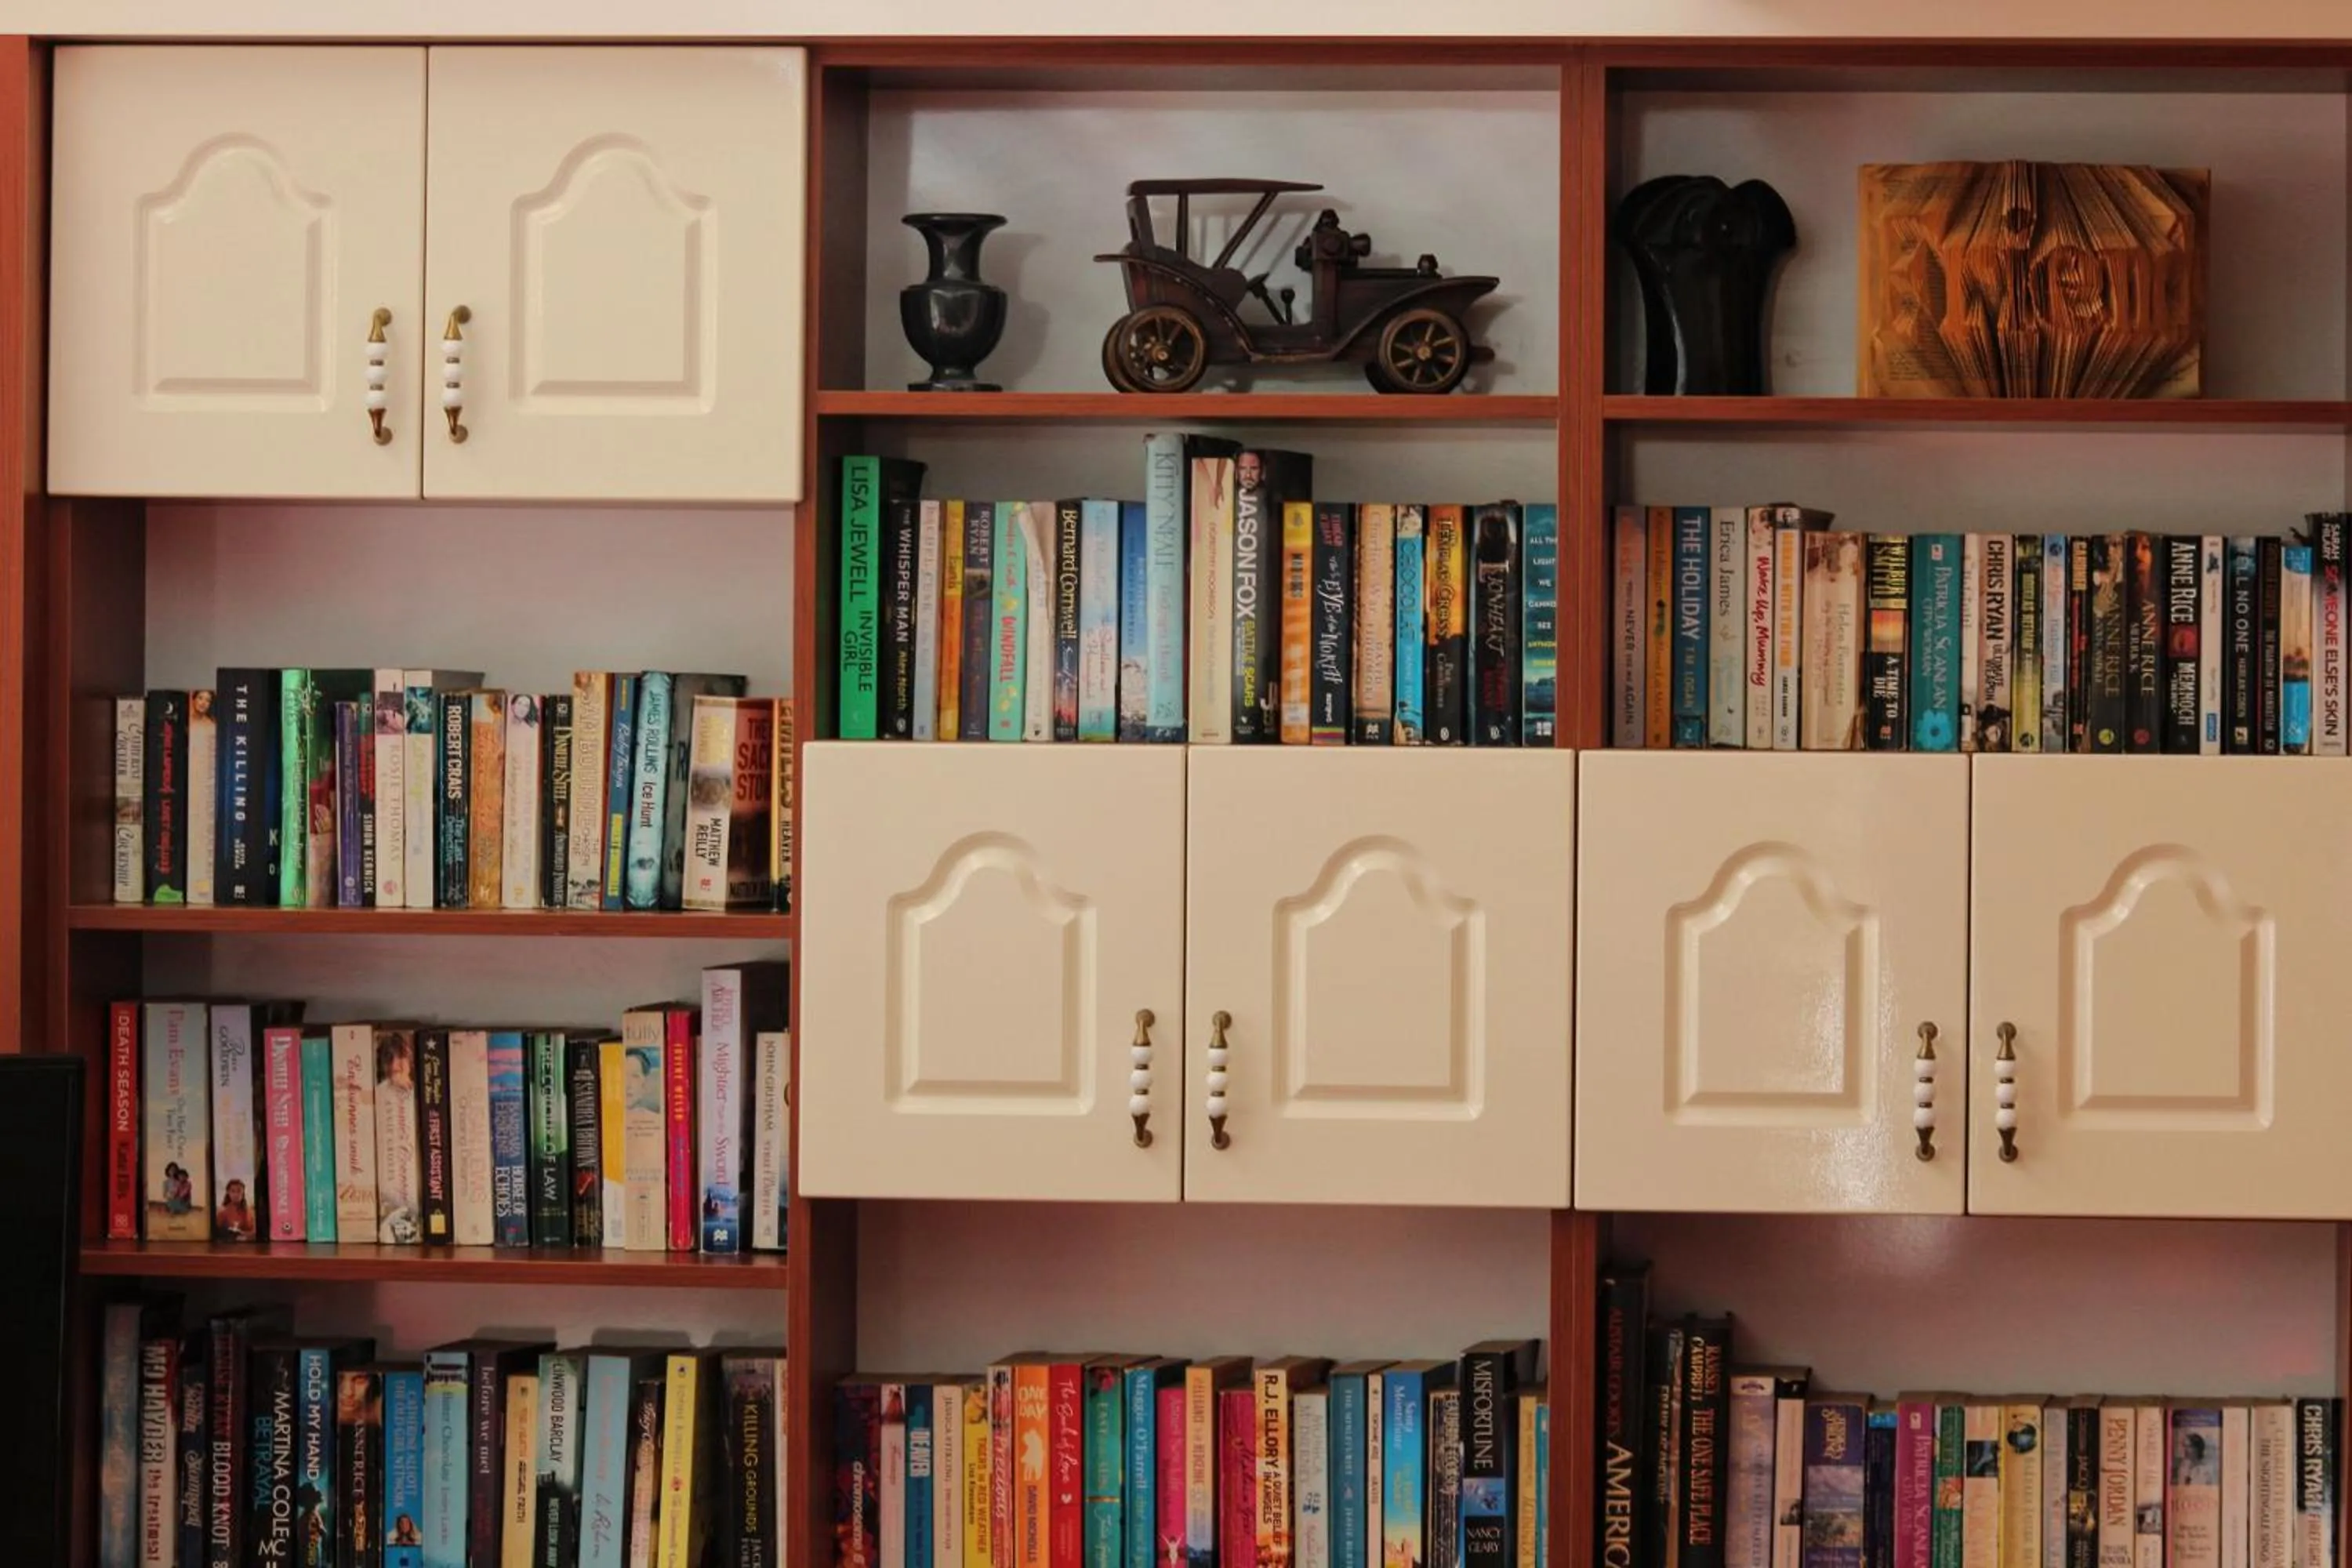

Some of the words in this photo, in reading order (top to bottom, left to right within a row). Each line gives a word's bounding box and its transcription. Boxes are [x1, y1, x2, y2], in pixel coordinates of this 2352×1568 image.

[850, 466, 869, 511] LISA
[978, 510, 990, 564] ROBERT
[1062, 509, 1079, 572] Bernard
[1237, 488, 1258, 570] JASON
[1682, 516, 1700, 554] THE
[1719, 521, 1735, 563] Erica
[2331, 523, 2339, 559] SARAH
[849, 518, 869, 603] JEWELL
[896, 528, 912, 601] WHISPER
[1756, 556, 1769, 597] Wake
[1889, 543, 1907, 593] WILBUR
[1987, 540, 2005, 589] CHRIS
[2171, 542, 2195, 585] ANNE
[1059, 572, 1077, 639] Cornwell
[1236, 572, 1256, 619] FOX
[1478, 559, 1509, 657] LIONHEART
[1681, 557, 1701, 640] HOLIDAY
[1719, 567, 1735, 617] James
[1934, 566, 1951, 630] PATRICIA
[1987, 591, 2005, 641] RYAN
[2171, 587, 2195, 623] RICE
[2236, 590, 2250, 614] NO
[2325, 565, 2339, 646] SOMEONE
[896, 606, 911, 643] MAN
[1624, 609, 1635, 651] NEVER
[2106, 600, 2121, 652] ANNE
[2141, 600, 2155, 652] ANNE
[2236, 619, 2249, 653] ONE
[843, 630, 858, 673] GIRL
[858, 610, 873, 692] INVISIBLE
[999, 615, 1017, 683] WINDFALL
[1749, 626, 1769, 687] Mummy
[1887, 656, 1896, 666] A
[1933, 636, 1951, 708] SCANLAN
[2325, 649, 2339, 697] ELSE'S
[1243, 666, 1254, 707] SCARS
[1873, 677, 1886, 698] DIE
[1886, 667, 1898, 698] TIME
[2105, 655, 2120, 698] RICE
[2141, 655, 2154, 697] RICE
[2178, 662, 2195, 725] MEMNOCH
[236, 684, 247, 722] THE
[648, 691, 662, 725] JAMES
[1624, 684, 1635, 724] AGAIN
[1886, 702, 1897, 718] TO
[2325, 699, 2338, 735] SKIN
[448, 705, 462, 757] ROBERT
[644, 728, 661, 774] ROLLINS
[236, 736, 246, 822] KILLING
[448, 759, 461, 799] CRAIS
[642, 782, 655, 797] Ice
[641, 800, 654, 829] Hunt
[696, 824, 709, 859] REILLY
[708, 818, 721, 867] MATTHEW
[118, 1016, 129, 1065] DEATH
[764, 1040, 775, 1074] JOHN
[167, 1048, 184, 1095] Evans
[711, 1041, 731, 1102] Mightier
[118, 1069, 129, 1131] SEASON
[764, 1076, 775, 1131] GRISHAM
[429, 1118, 441, 1147] FIRST
[544, 1142, 555, 1163] OF
[544, 1167, 557, 1200] LAW
[715, 1137, 731, 1185] Sword
[495, 1166, 511, 1218] ECHOES
[144, 1345, 166, 1379] MO
[308, 1355, 321, 1400] HOLD
[1705, 1345, 1720, 1395] RAMSEY
[480, 1366, 494, 1414] before
[551, 1363, 564, 1412] LINWOOD
[1134, 1374, 1147, 1423] Maggie
[1265, 1374, 1278, 1404] R.J.
[143, 1384, 166, 1463] HAYDER
[274, 1390, 290, 1477] MARTINA
[308, 1404, 321, 1432] MY
[354, 1418, 364, 1457] ANNE
[480, 1419, 491, 1441] we
[743, 1404, 758, 1467] KILLING
[1265, 1408, 1278, 1468] ELLORY
[1473, 1359, 1494, 1469] MISFORTUNE
[1692, 1409, 1715, 1435] THE
[2304, 1405, 2323, 1456] CHRIS
[307, 1432, 321, 1480] HAND
[478, 1446, 492, 1474] met
[550, 1415, 564, 1463] BARCLAY
[910, 1431, 929, 1477] DEAVER
[1135, 1428, 1148, 1489] O'Farrell
[1691, 1439, 1713, 1465] ONE
[2106, 1417, 2127, 1465] PENNY
[147, 1469, 162, 1488] the
[212, 1441, 231, 1497] BLOOD
[254, 1416, 272, 1511] BETRAYAL
[353, 1459, 364, 1495] RICE
[994, 1436, 1007, 1519] Precious
[1691, 1468, 1712, 1501] SAFE
[1915, 1435, 1932, 1498] PATRICIA
[2304, 1458, 2323, 1507] RYAN
[274, 1484, 290, 1537] COLE
[852, 1461, 865, 1547] chromosome
[1272, 1481, 1281, 1510] QUIET
[1606, 1441, 1635, 1568] AMERIC
[2102, 1467, 2128, 1526] JORDAN
[212, 1502, 230, 1548] KNOT
[978, 1508, 986, 1554] WEATHER
[1690, 1504, 1712, 1545] PLACE
[853, 1552, 863, 1563] 6
